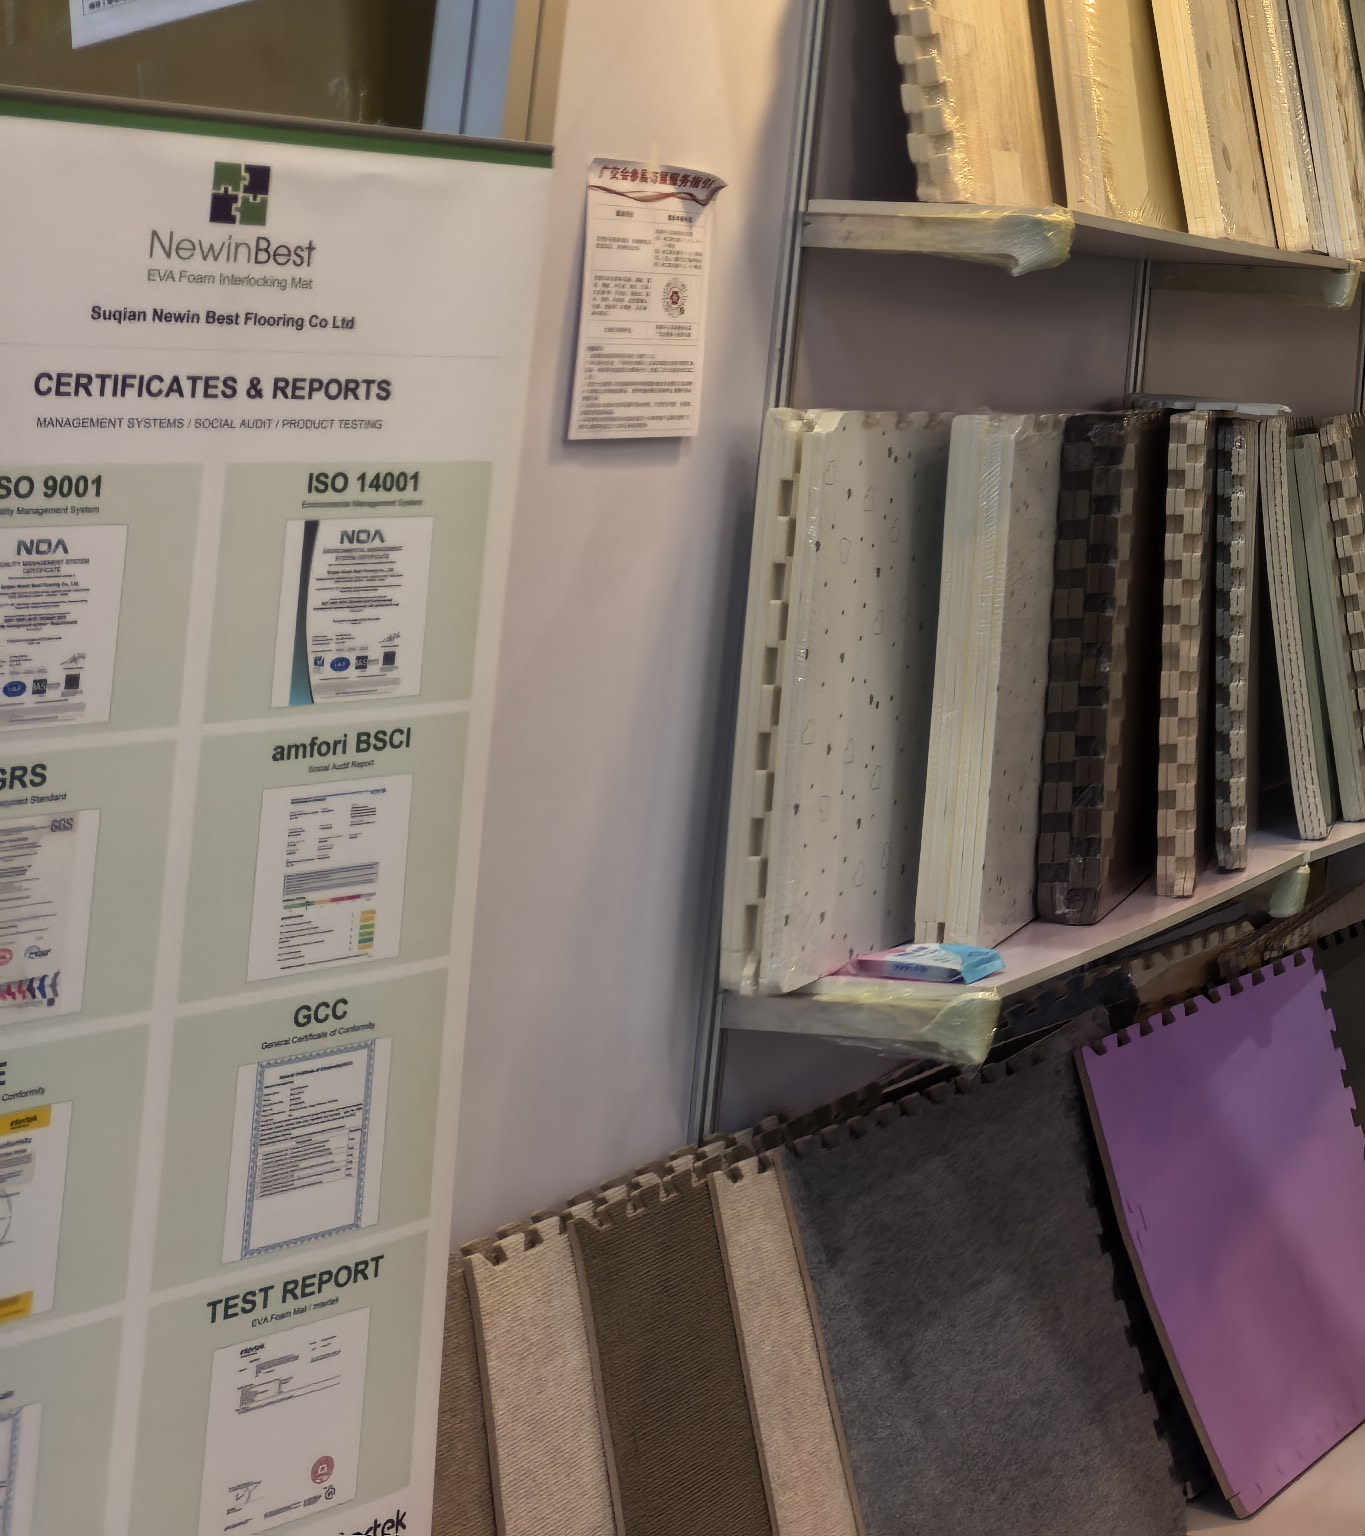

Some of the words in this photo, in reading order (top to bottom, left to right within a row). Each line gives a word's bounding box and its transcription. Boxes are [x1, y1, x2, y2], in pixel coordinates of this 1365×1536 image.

[149, 229, 317, 268] NewinBest
[147, 268, 176, 283] EVA
[178, 270, 215, 285] Foam
[219, 272, 288, 291] Interlocking
[290, 277, 314, 290] Mat
[90, 305, 147, 325] Suqian
[151, 307, 201, 325] Newin
[205, 310, 240, 327] Best
[243, 311, 305, 331] Flooring
[308, 315, 328, 330] Co
[331, 315, 356, 331] Ltd
[33, 372, 239, 400] CERTIFICATES
[245, 377, 264, 400] &
[271, 376, 393, 402] REPORTS
[36, 417, 123, 430] MANAGEMENT
[127, 417, 184, 430] SYSTEMS
[194, 418, 236, 431] SOCIAL
[239, 418, 272, 431] AUDIT
[282, 419, 335, 431] PRODUCT
[338, 419, 383, 431] TESTING
[0, 475, 36, 500] SO
[43, 474, 103, 499] 9001
[307, 471, 349, 494] ISO
[356, 470, 421, 493] 14001
[17, 505, 69, 516] Management
[70, 504, 100, 515] System
[271, 733, 349, 762] amfori
[355, 726, 412, 754] BSCI
[30, 792, 68, 805] Standard
[50, 817, 75, 833] SGS
[293, 997, 349, 1028] GCC
[261, 1036, 291, 1050] General
[291, 1030, 329, 1045] Certificate
[338, 1021, 376, 1036] Conformity
[1, 1086, 46, 1102] Conformity
[206, 1284, 275, 1324] TEST
[281, 1254, 385, 1305] REPORT
[251, 1316, 269, 1328] EVA
